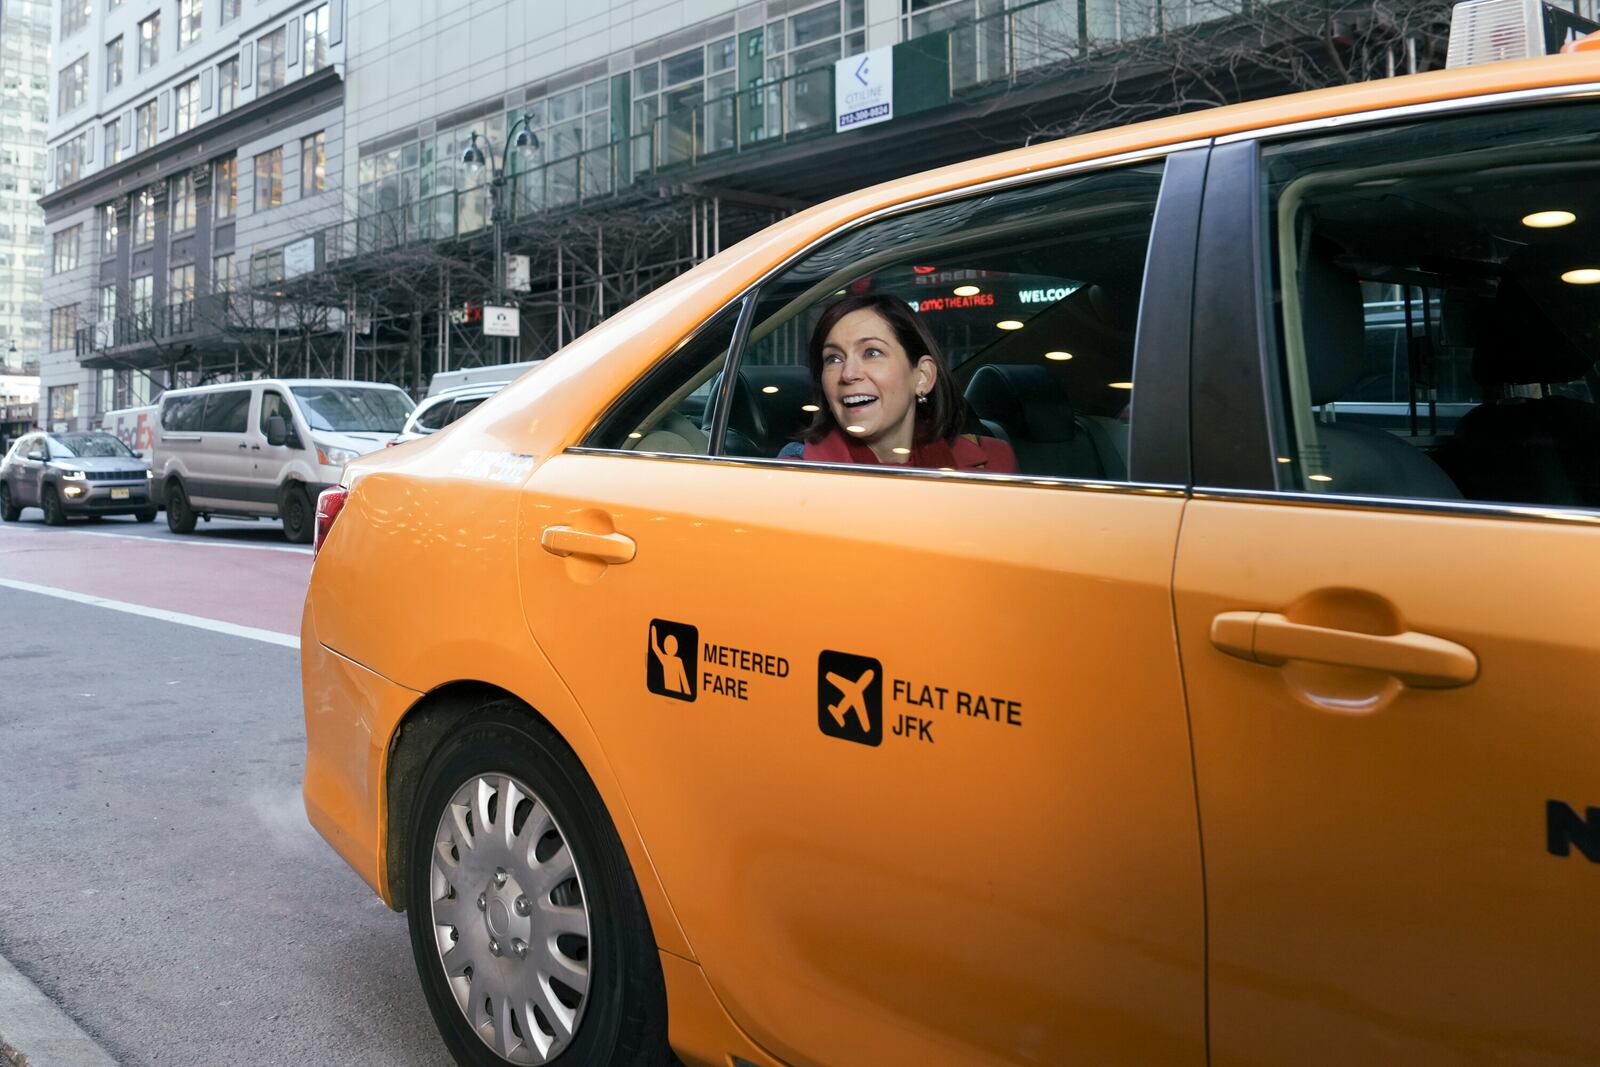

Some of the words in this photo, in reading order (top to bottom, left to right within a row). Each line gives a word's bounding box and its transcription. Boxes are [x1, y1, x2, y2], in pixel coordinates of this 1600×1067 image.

[944, 294, 995, 309] THEATRES
[703, 643, 790, 678] METERED
[703, 672, 749, 700] FARE
[893, 679, 949, 711] FLAT
[956, 691, 1022, 726] RATE
[892, 714, 934, 743] JFK
